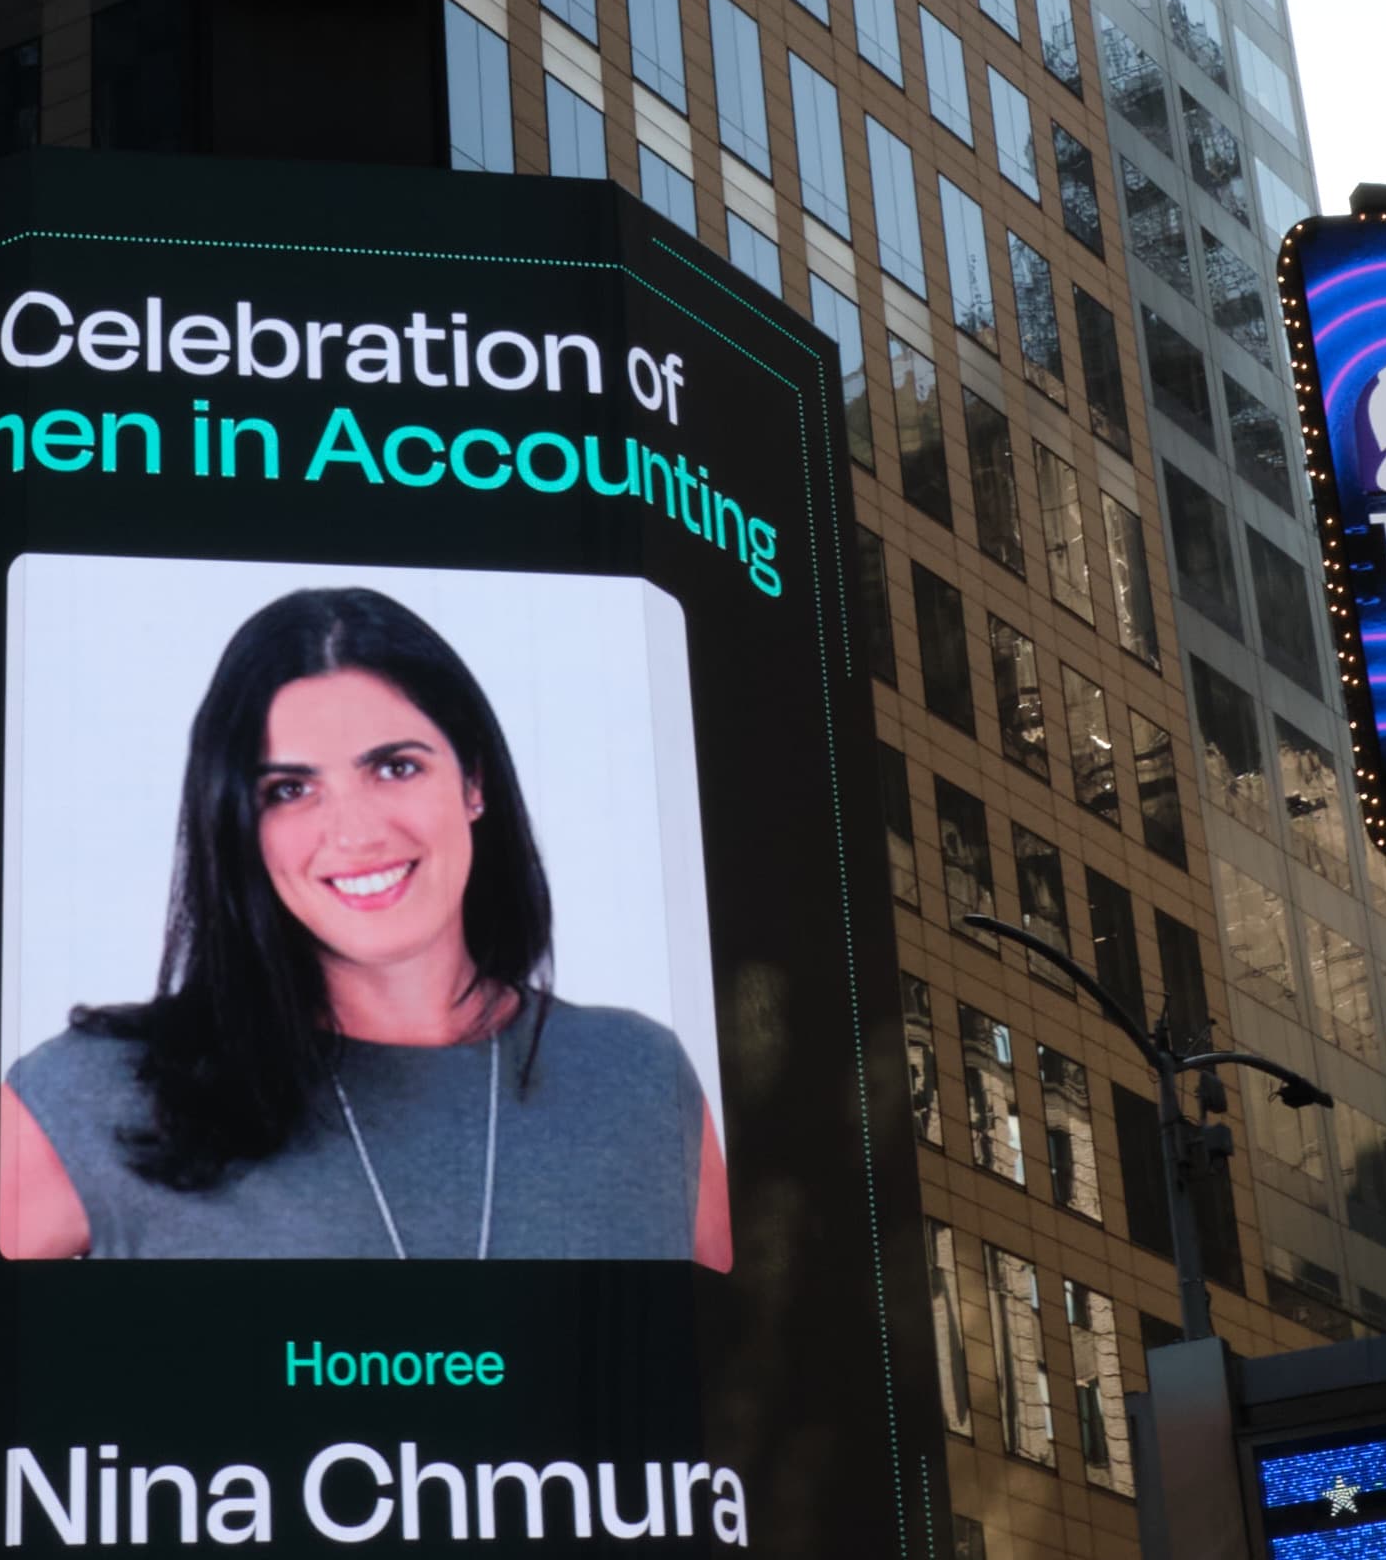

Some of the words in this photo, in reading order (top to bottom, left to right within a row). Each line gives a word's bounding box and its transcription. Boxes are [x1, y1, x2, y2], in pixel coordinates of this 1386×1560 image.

[1, 291, 602, 393] Celebration
[628, 347, 683, 425] of
[194, 400, 279, 479] in
[305, 408, 781, 596] Accounting
[287, 1342, 504, 1385] Honoree
[6, 1445, 271, 1546] Nina
[304, 1442, 747, 1546] Chmura
